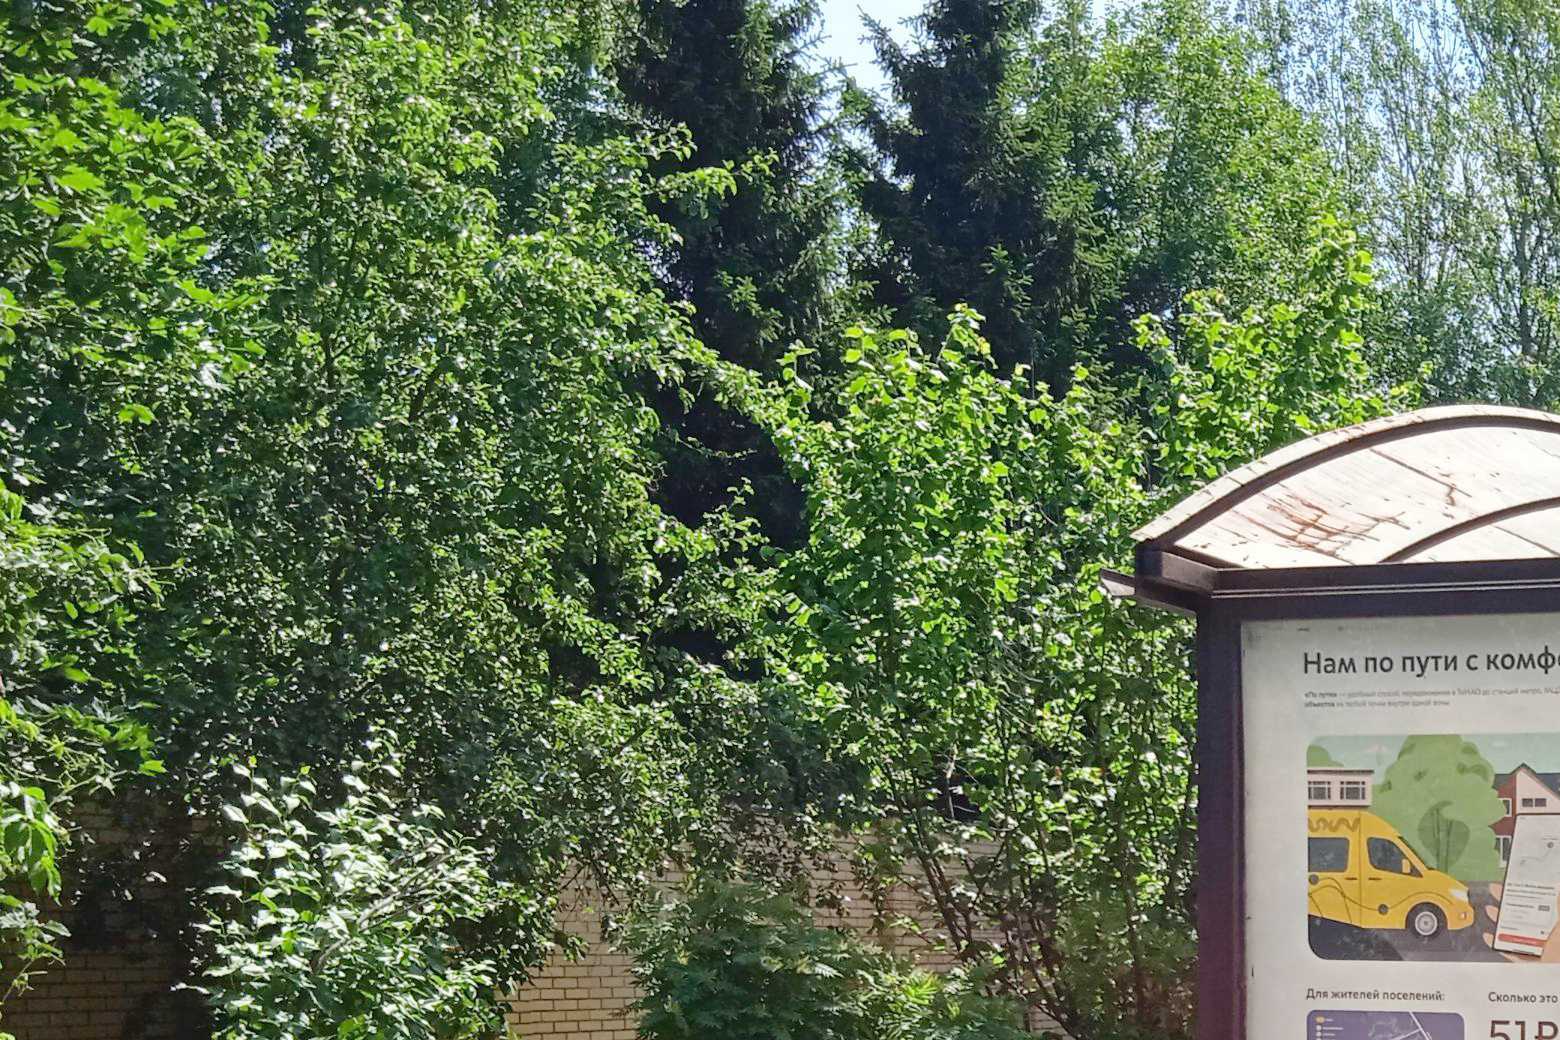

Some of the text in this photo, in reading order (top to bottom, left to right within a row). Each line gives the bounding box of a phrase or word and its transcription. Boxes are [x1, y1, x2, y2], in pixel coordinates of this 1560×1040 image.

[1303, 651, 1357, 675] Нам
[1364, 654, 1394, 674] по
[1403, 652, 1458, 678] пути
[1466, 654, 1478, 672] с
[1306, 988, 1446, 1001] Для жителей поселений:
[1488, 992, 1537, 1003] Сколько
[1539, 994, 1558, 1003] это
